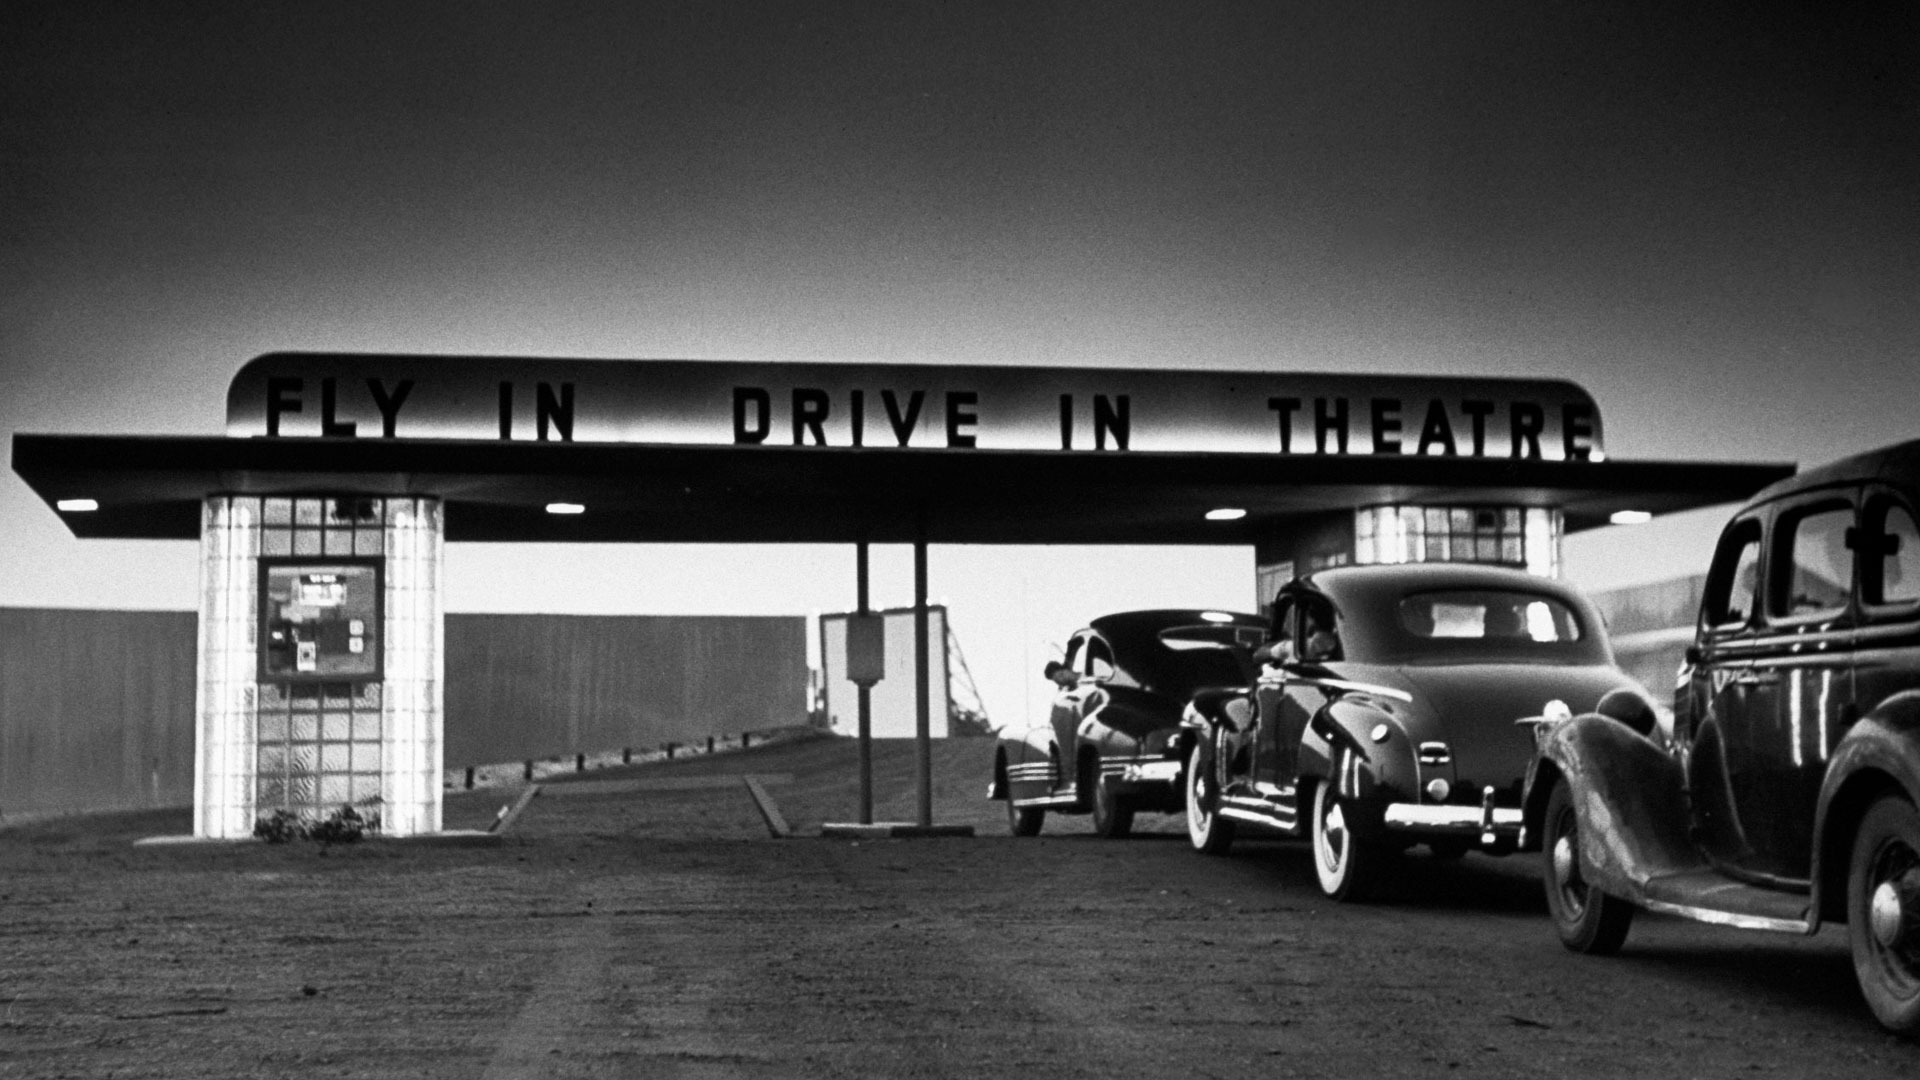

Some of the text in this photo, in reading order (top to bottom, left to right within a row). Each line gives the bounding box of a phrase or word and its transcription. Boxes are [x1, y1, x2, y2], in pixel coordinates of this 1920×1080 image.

[266, 377, 1594, 460] FLY IN DRIVE IN THEATRE
